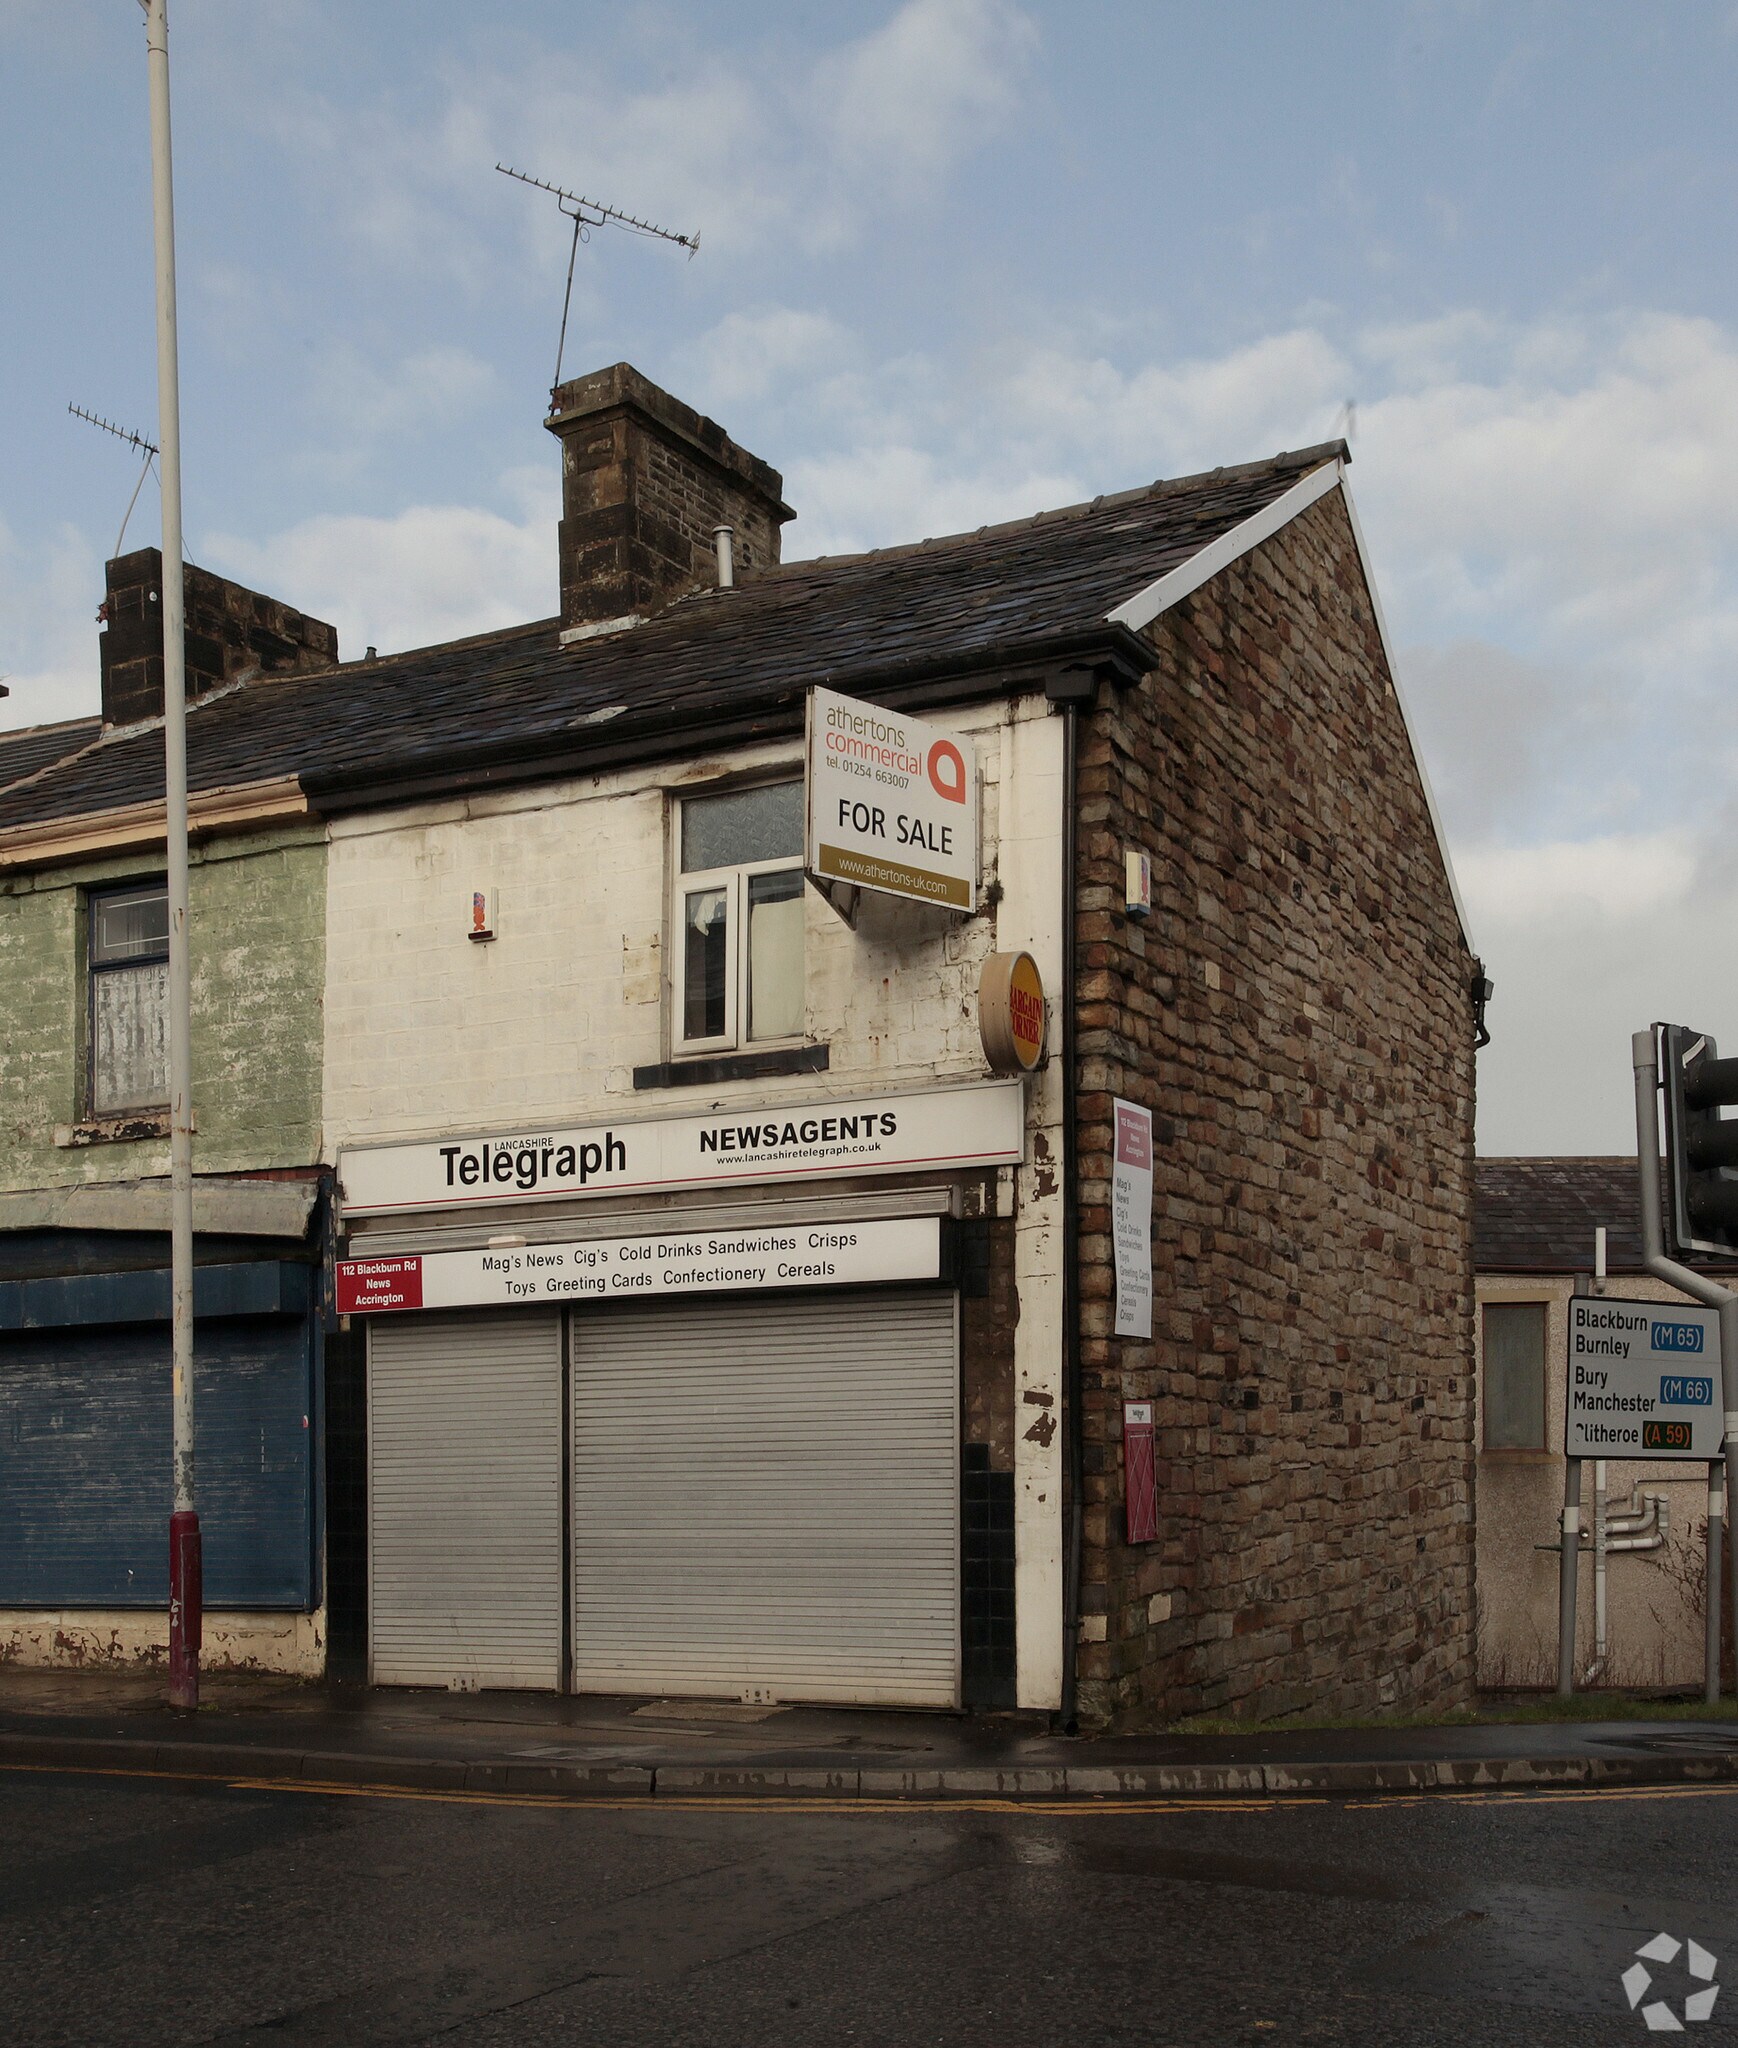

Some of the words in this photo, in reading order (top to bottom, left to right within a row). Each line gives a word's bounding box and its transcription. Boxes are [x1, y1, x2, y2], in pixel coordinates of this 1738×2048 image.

[826, 705, 905, 748] athertons
[825, 731, 922, 777] commercial
[826, 755, 840, 770] tel.
[843, 761, 871, 779] 01254
[875, 769, 909, 790] 663007
[839, 799, 886, 838] FOR
[896, 814, 953, 855] SALE
[839, 857, 947, 895] www.athertons-uk.com
[1012, 1012, 1040, 1045] ORNER
[700, 1112, 898, 1152] NEWSAGENTS
[494, 1137, 554, 1151] LANCASHIRE
[716, 1142, 882, 1165] www.lancashiretelegraph.co.uk
[440, 1132, 626, 1190] Telegraph
[1116, 1177, 1131, 1192] Mag's
[1116, 1192, 1130, 1205] News
[1116, 1207, 1128, 1221] Cig's
[1116, 1221, 1127, 1234] Cold
[1128, 1224, 1142, 1237] Drinks
[482, 1255, 521, 1273] Mag's
[526, 1254, 564, 1268] News
[574, 1249, 608, 1268] Cig's
[619, 1246, 651, 1261] Cold
[657, 1242, 702, 1259] Drinks
[708, 1236, 797, 1255] Sandwiches
[808, 1233, 857, 1250] Crisps
[1117, 1236, 1143, 1251] Sandwiches
[341, 1265, 355, 1276] 112
[357, 1262, 402, 1275] Blackburn
[404, 1260, 417, 1271] Rd
[505, 1280, 536, 1297] Toys
[546, 1275, 606, 1294] Greeting
[611, 1272, 652, 1288] Cards
[663, 1266, 766, 1285] Confectionery
[777, 1261, 835, 1278] Cereals
[366, 1279, 391, 1290] News
[355, 1293, 404, 1306] Accrington
[1119, 1309, 1135, 1323] Crisps
[1576, 1308, 1648, 1331] Blackburn
[1576, 1334, 1630, 1359] Burnley
[1654, 1325, 1673, 1348] (M
[1677, 1327, 1700, 1351] 65)
[1575, 1366, 1608, 1389] Bury
[1574, 1391, 1656, 1412] Manchester
[1663, 1379, 1682, 1402] (M
[1685, 1381, 1709, 1403] 66)
[1645, 1423, 1661, 1447] (A
[1666, 1425, 1690, 1448] 59)
